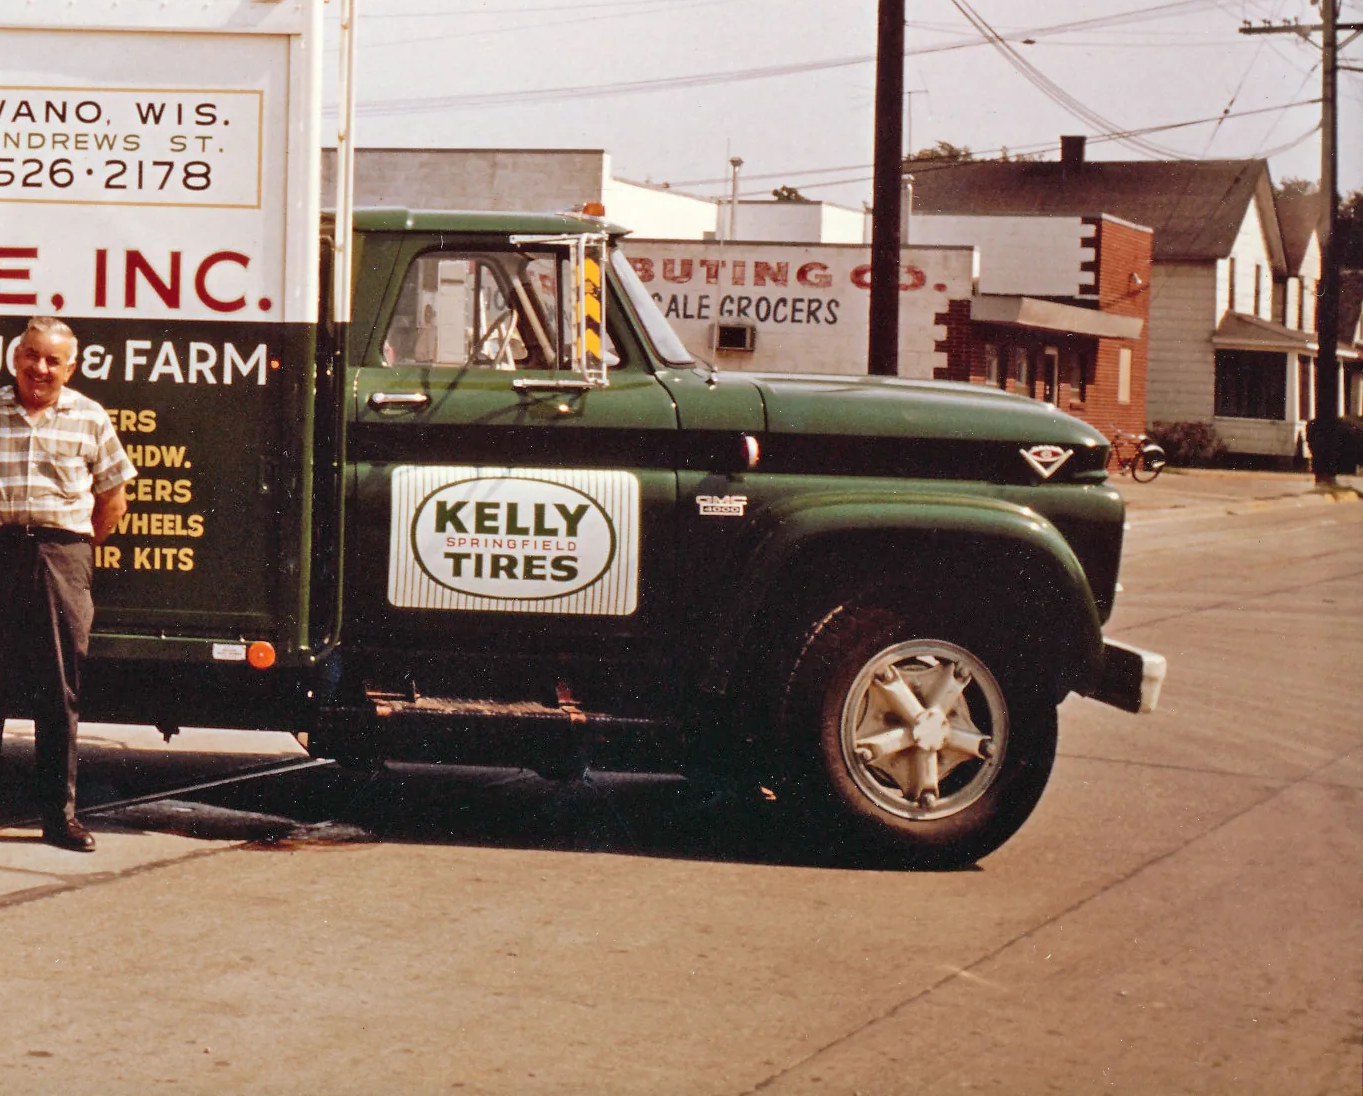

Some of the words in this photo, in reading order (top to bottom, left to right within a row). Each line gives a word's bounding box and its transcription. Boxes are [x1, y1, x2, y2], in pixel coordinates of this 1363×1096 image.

[135, 102, 230, 126] WIS.
[170, 135, 224, 153] ST.
[94, 248, 272, 312] INC.
[626, 257, 833, 288] BUTING
[652, 293, 710, 319] ALE
[719, 295, 839, 325] GROCERS
[81, 344, 113, 380] &
[124, 341, 267, 386] FARM
[126, 444, 192, 469] HDW.
[125, 478, 192, 503] CERS
[695, 495, 748, 505] GMC
[434, 500, 590, 537] KELLY
[446, 537, 577, 551] SPRINGFIELD
[133, 547, 194, 571] KITS
[444, 552, 578, 582] TIRES
